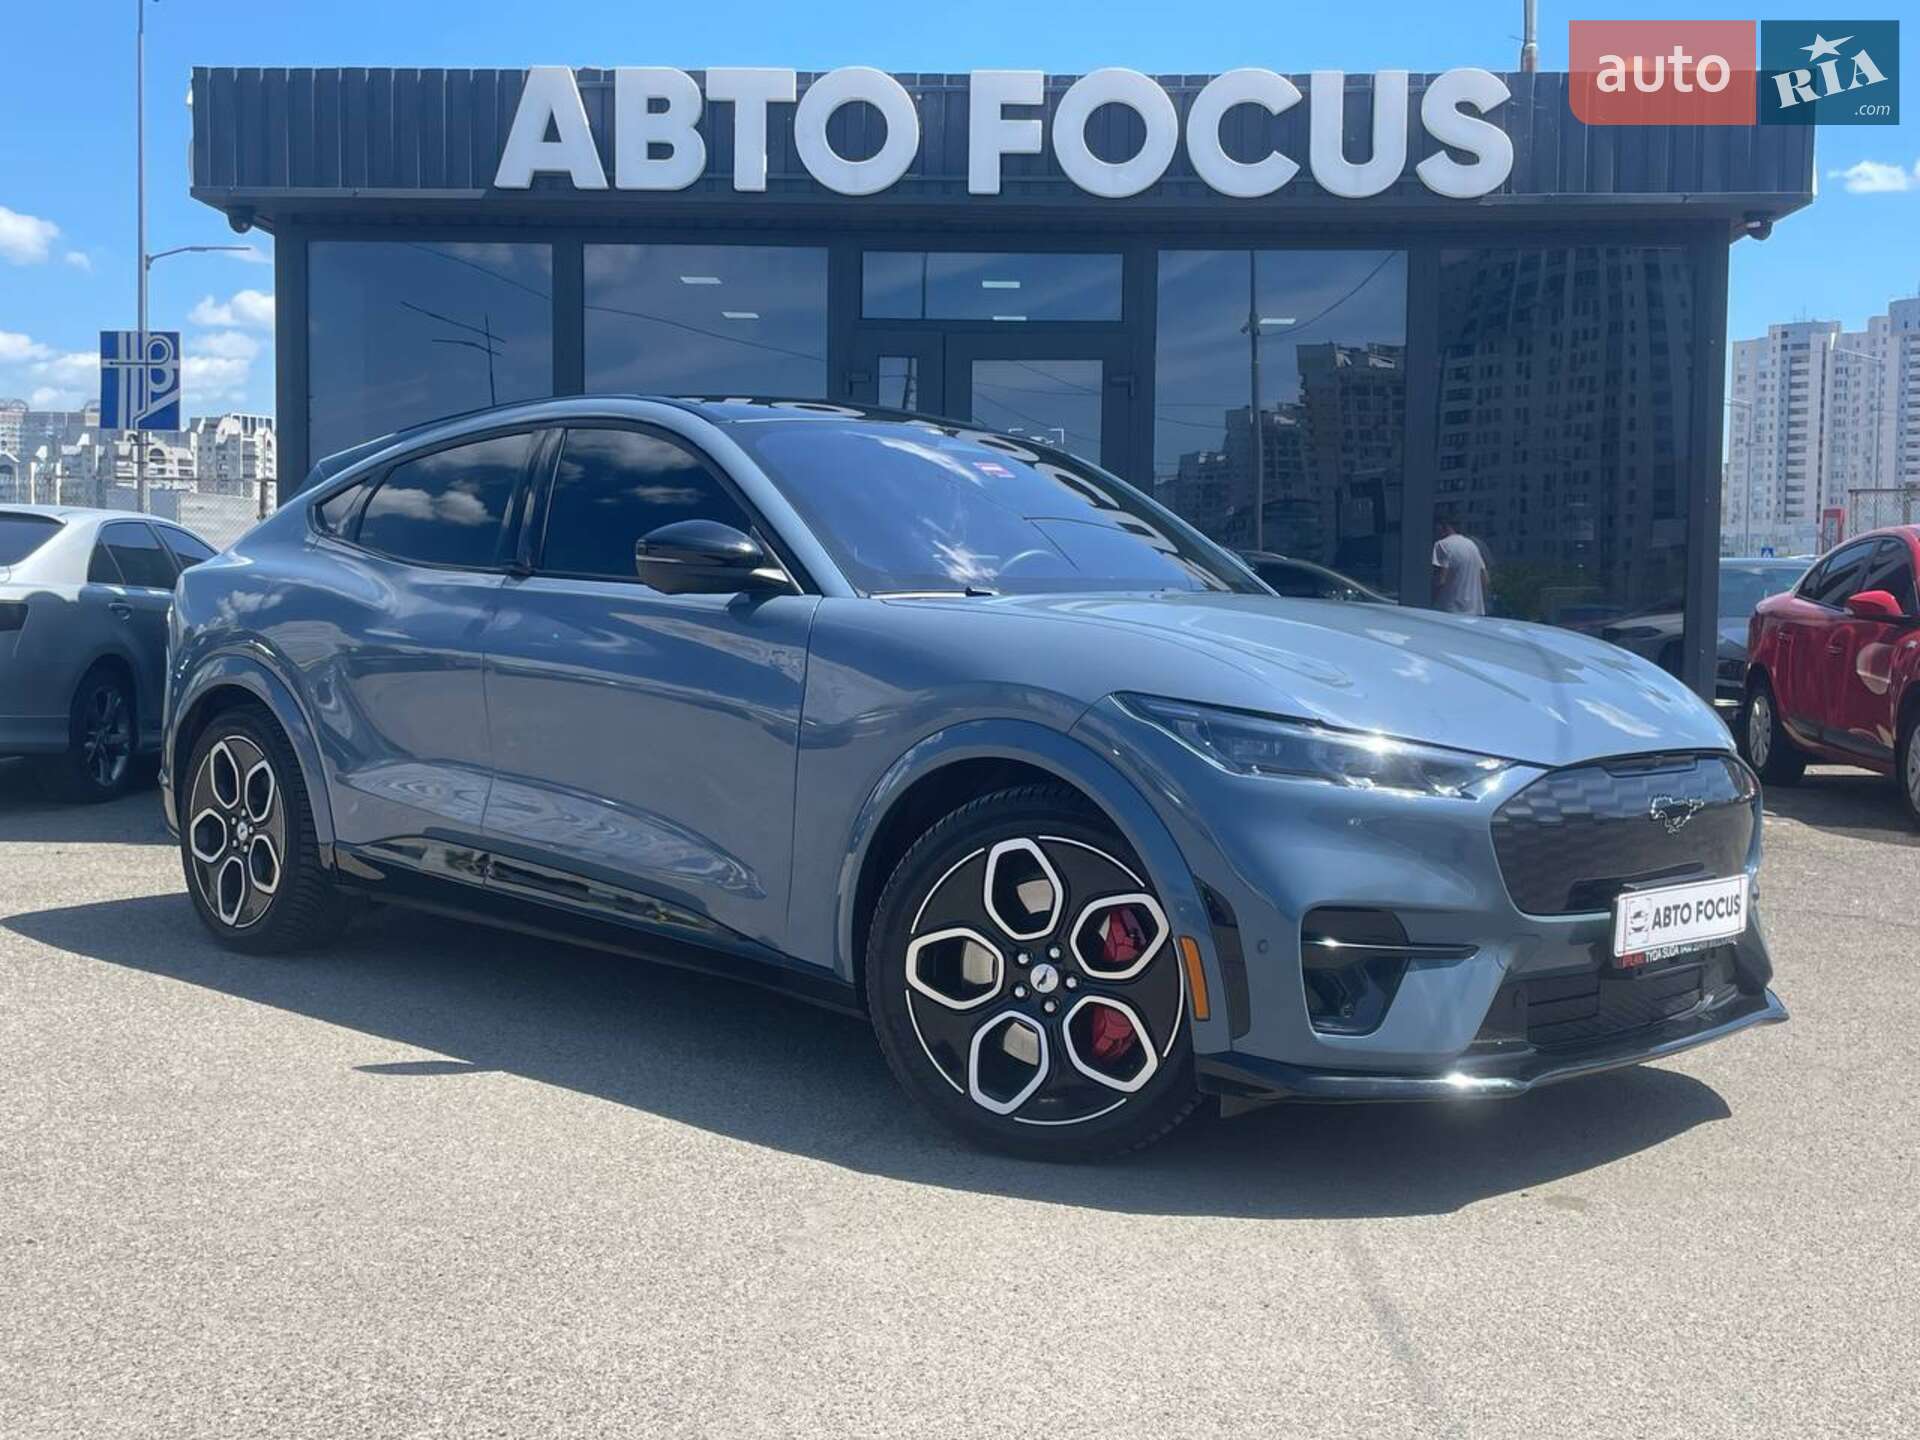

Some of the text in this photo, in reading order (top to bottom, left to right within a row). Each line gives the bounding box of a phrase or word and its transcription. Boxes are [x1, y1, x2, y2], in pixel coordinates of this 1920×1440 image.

[494, 65, 1514, 198] АВТО FOCUS
[1651, 894, 1741, 930] АВТО FOCUS
